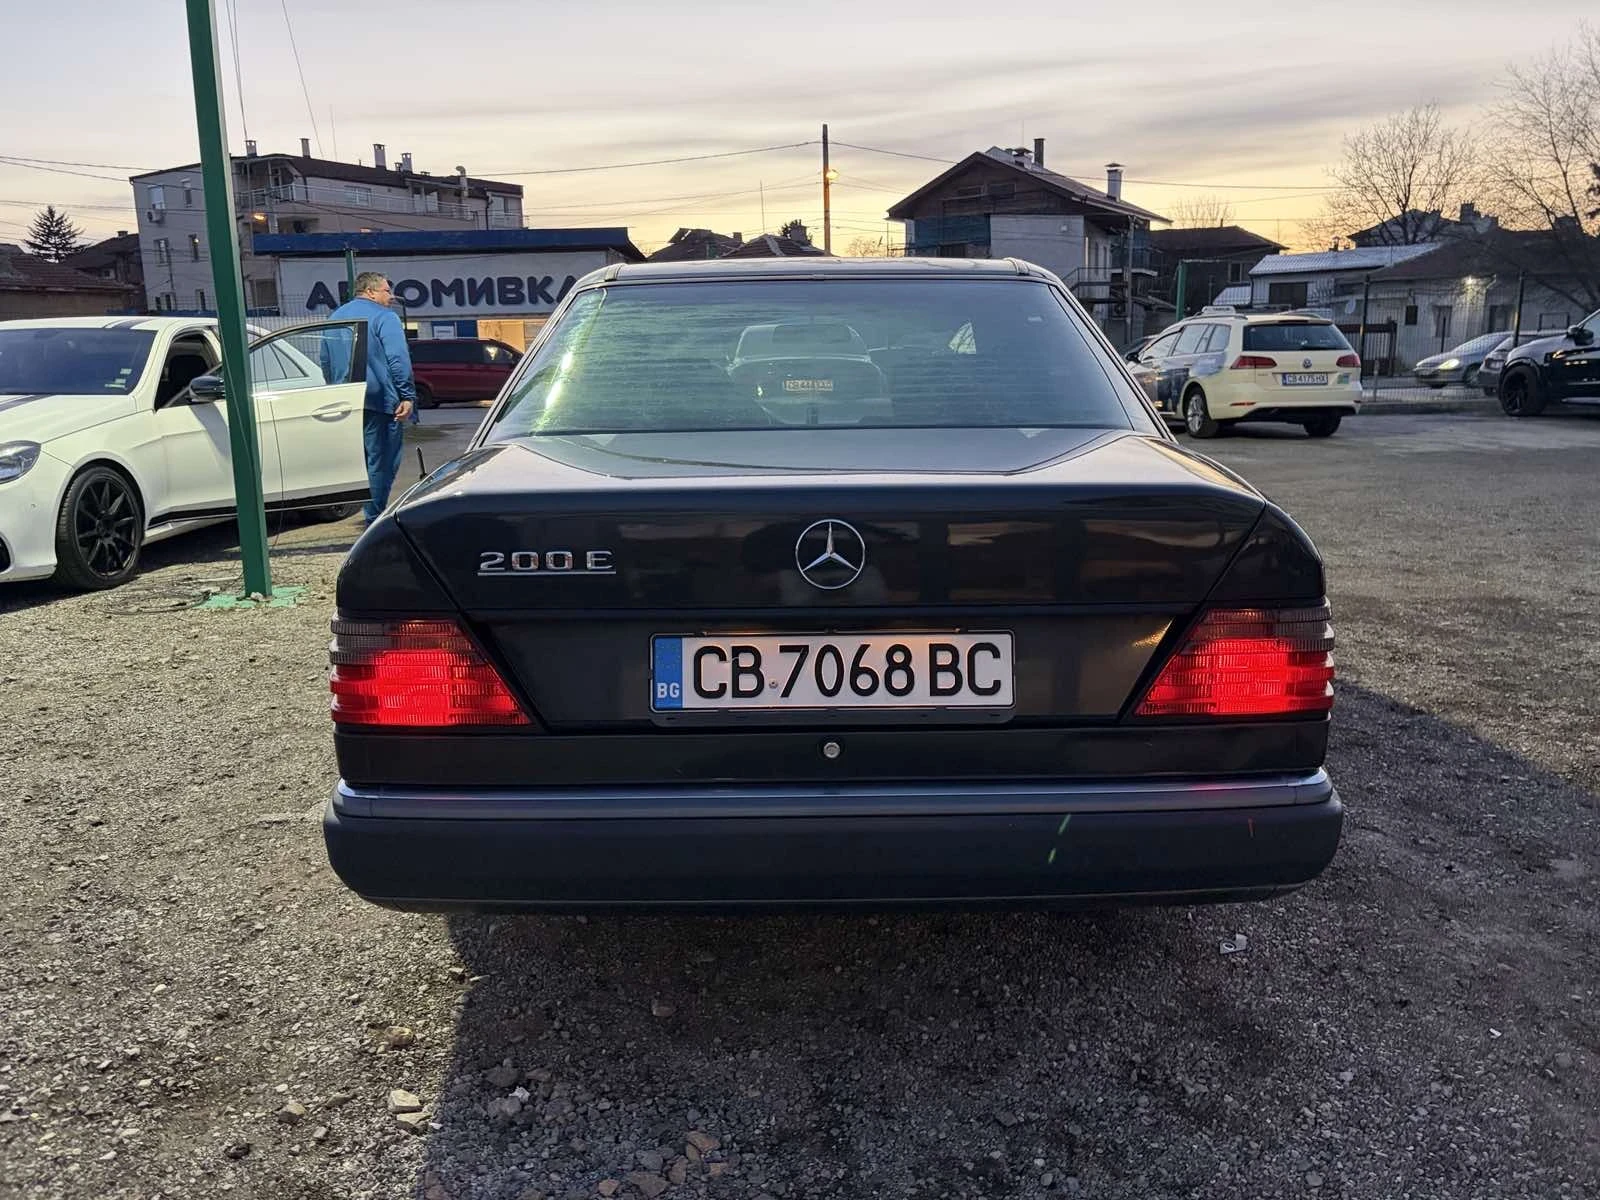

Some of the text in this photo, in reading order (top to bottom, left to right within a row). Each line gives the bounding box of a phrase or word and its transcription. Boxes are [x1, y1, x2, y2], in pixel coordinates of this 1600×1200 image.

[305, 275, 577, 310] АОМИВКА
[479, 550, 612, 571] 200 E
[693, 642, 1002, 699] CB 7068 BC
[657, 682, 680, 698] BG
